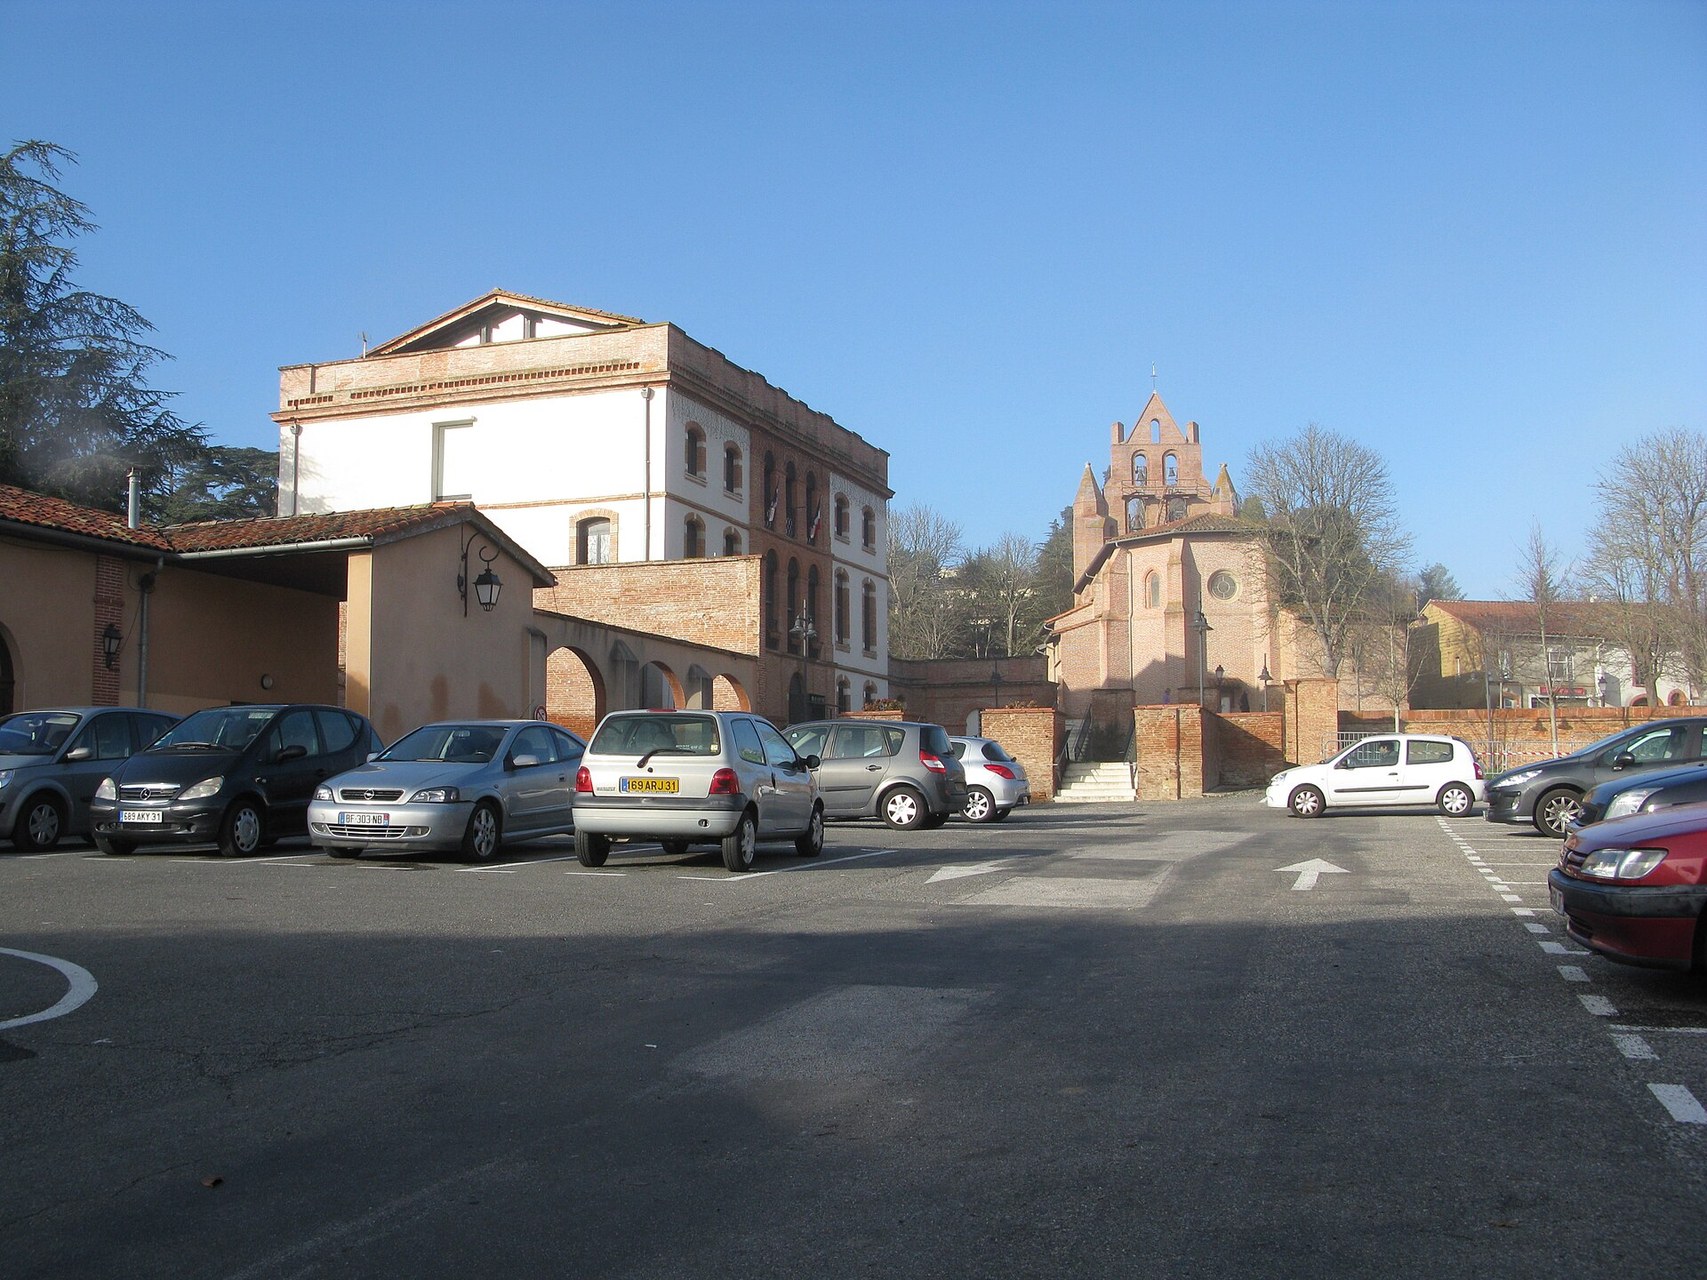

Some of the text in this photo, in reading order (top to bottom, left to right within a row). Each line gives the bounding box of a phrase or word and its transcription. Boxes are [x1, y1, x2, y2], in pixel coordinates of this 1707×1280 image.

[628, 780, 676, 791] 169 ARJ 31
[137, 812, 150, 821] AKY
[151, 812, 161, 821] 31
